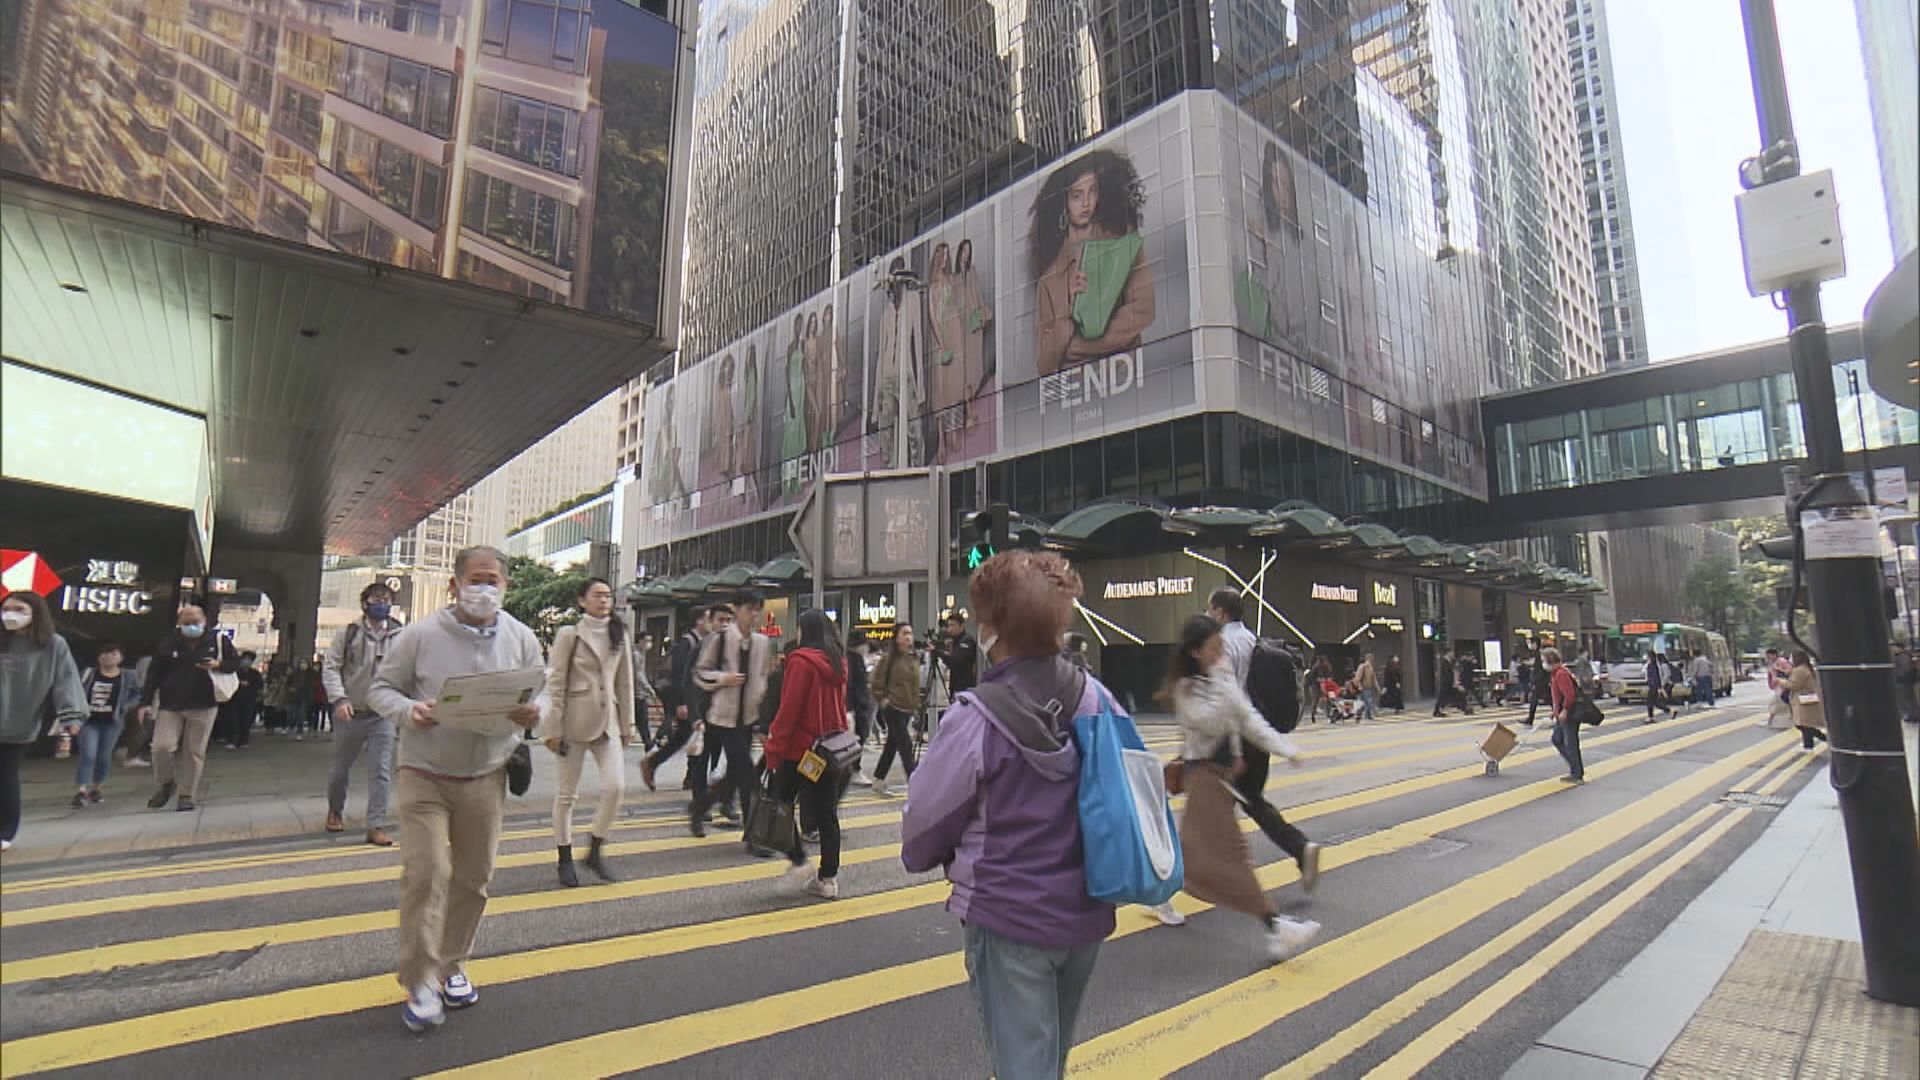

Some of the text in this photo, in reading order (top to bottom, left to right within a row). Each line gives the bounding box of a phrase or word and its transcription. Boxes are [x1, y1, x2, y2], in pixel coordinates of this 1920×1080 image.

[1039, 347, 1144, 415] FENDI
[62, 585, 153, 615] HSBC
[1103, 577, 1194, 600] AUDEMARS PIGUET
